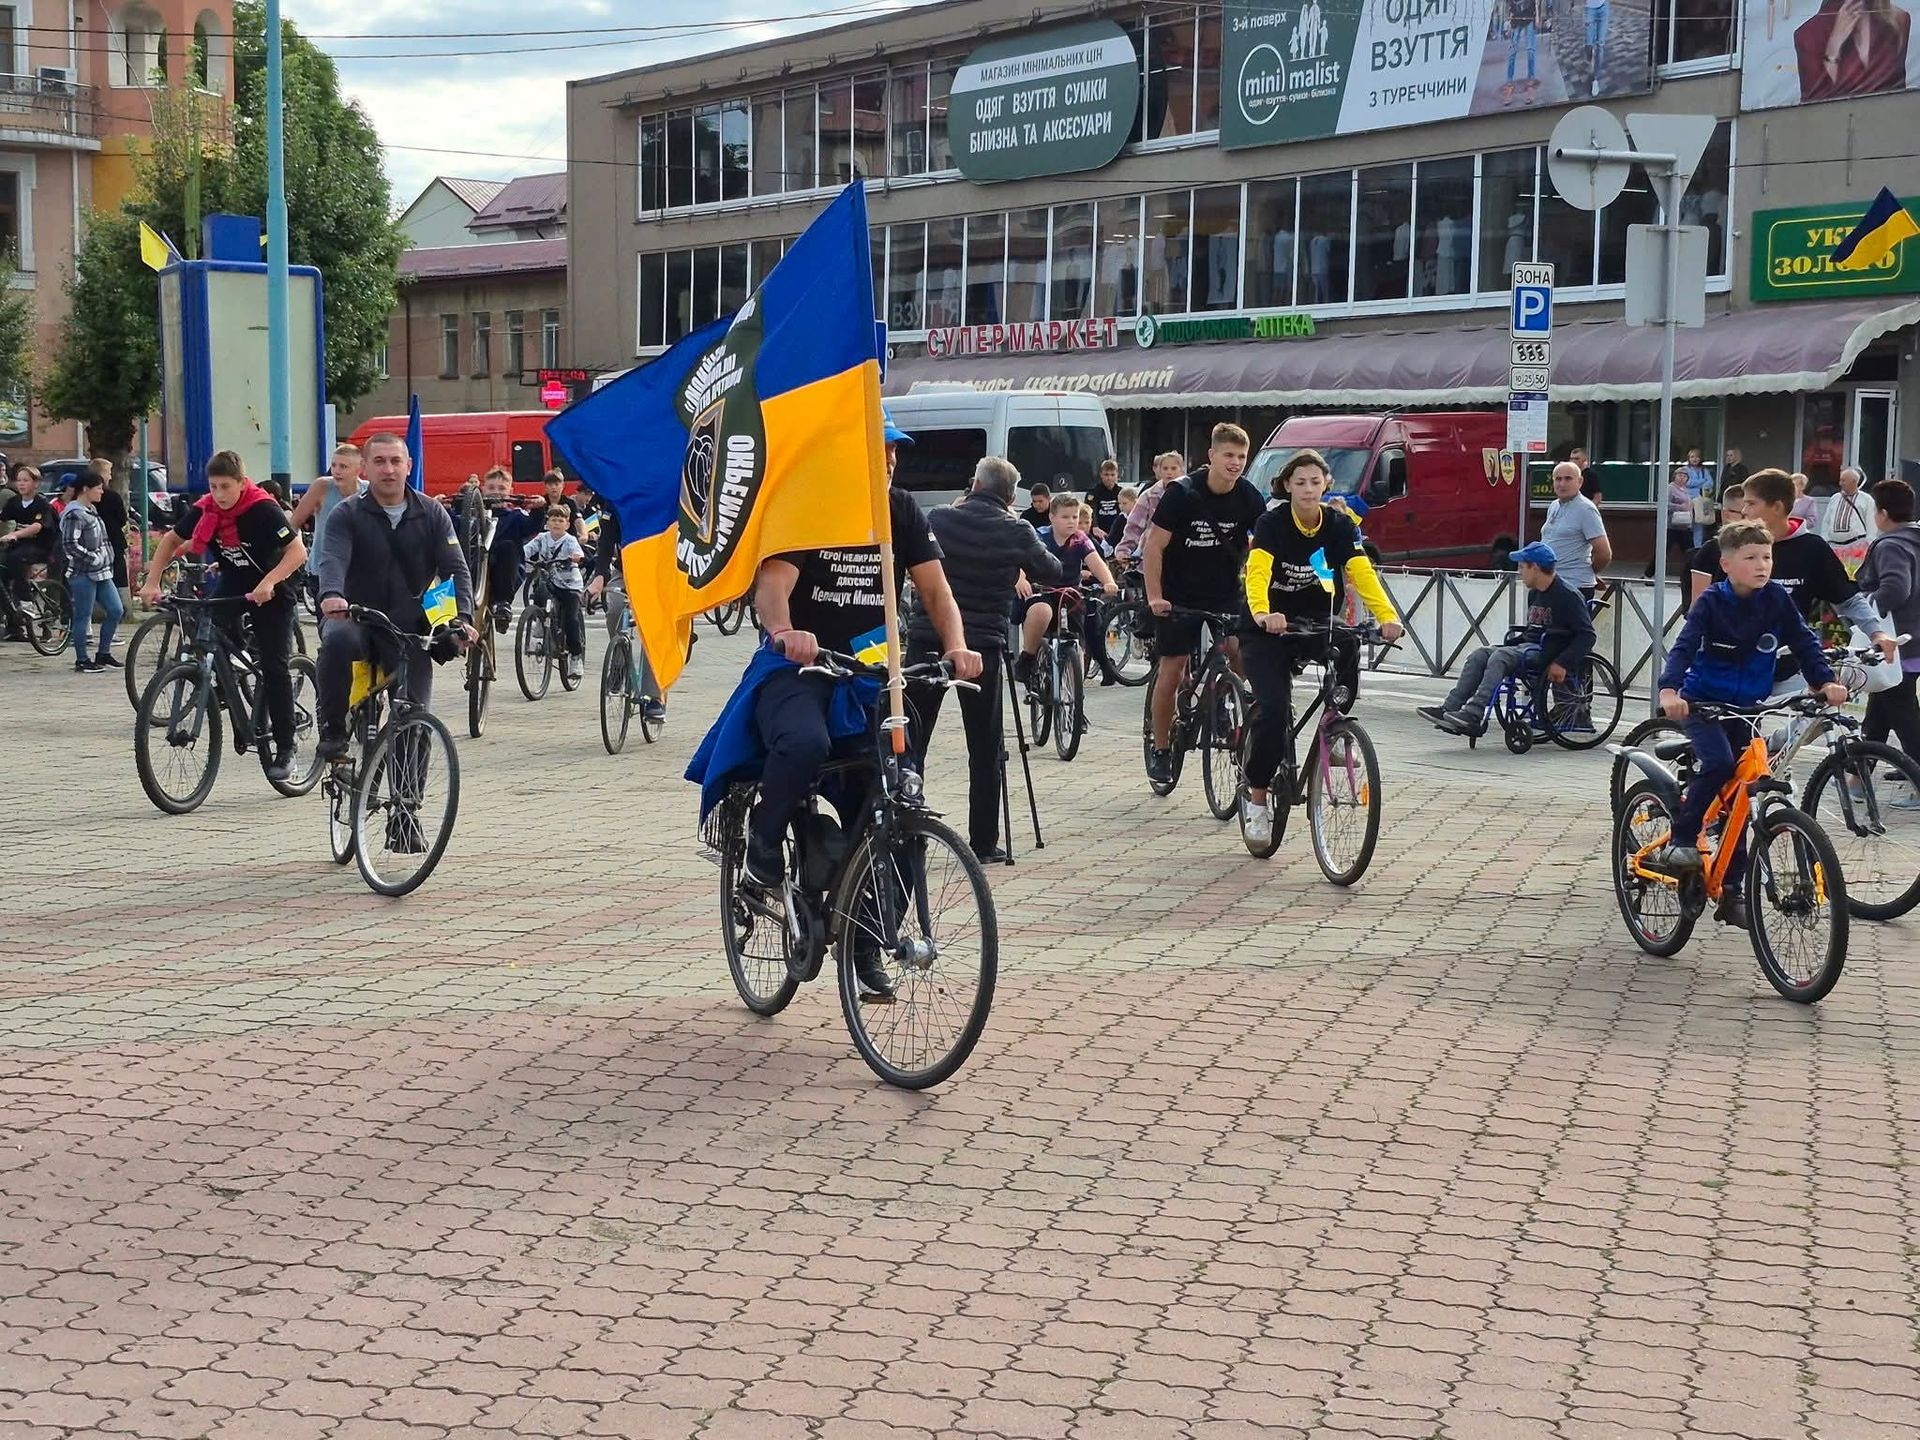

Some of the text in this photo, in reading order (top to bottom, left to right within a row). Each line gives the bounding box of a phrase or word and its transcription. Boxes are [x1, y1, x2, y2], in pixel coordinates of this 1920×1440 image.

[1250, 11, 1287, 29] поверх
[980, 47, 1103, 82] МАГАЗИН МІНІМАЛЬНИХ ЦІН
[1370, 25, 1469, 72] ВЗУТТЯ
[1245, 61, 1340, 97] mini malist
[1383, 76, 1467, 105] ТУРЕЧЧИНИ
[975, 78, 1107, 123] ОДЯГ ВЗУТТЯ СУМКИ
[970, 111, 1112, 153] БІЛИЗНА ТА АКСЕСУАРИ
[1515, 269, 1551, 284] ЗОНА
[926, 317, 1118, 358] СУПЕРМАРКЕТ
[1253, 313, 1316, 338] АПТЕКА
[1524, 374, 1533, 383] 25
[1535, 374, 1545, 384] 50
